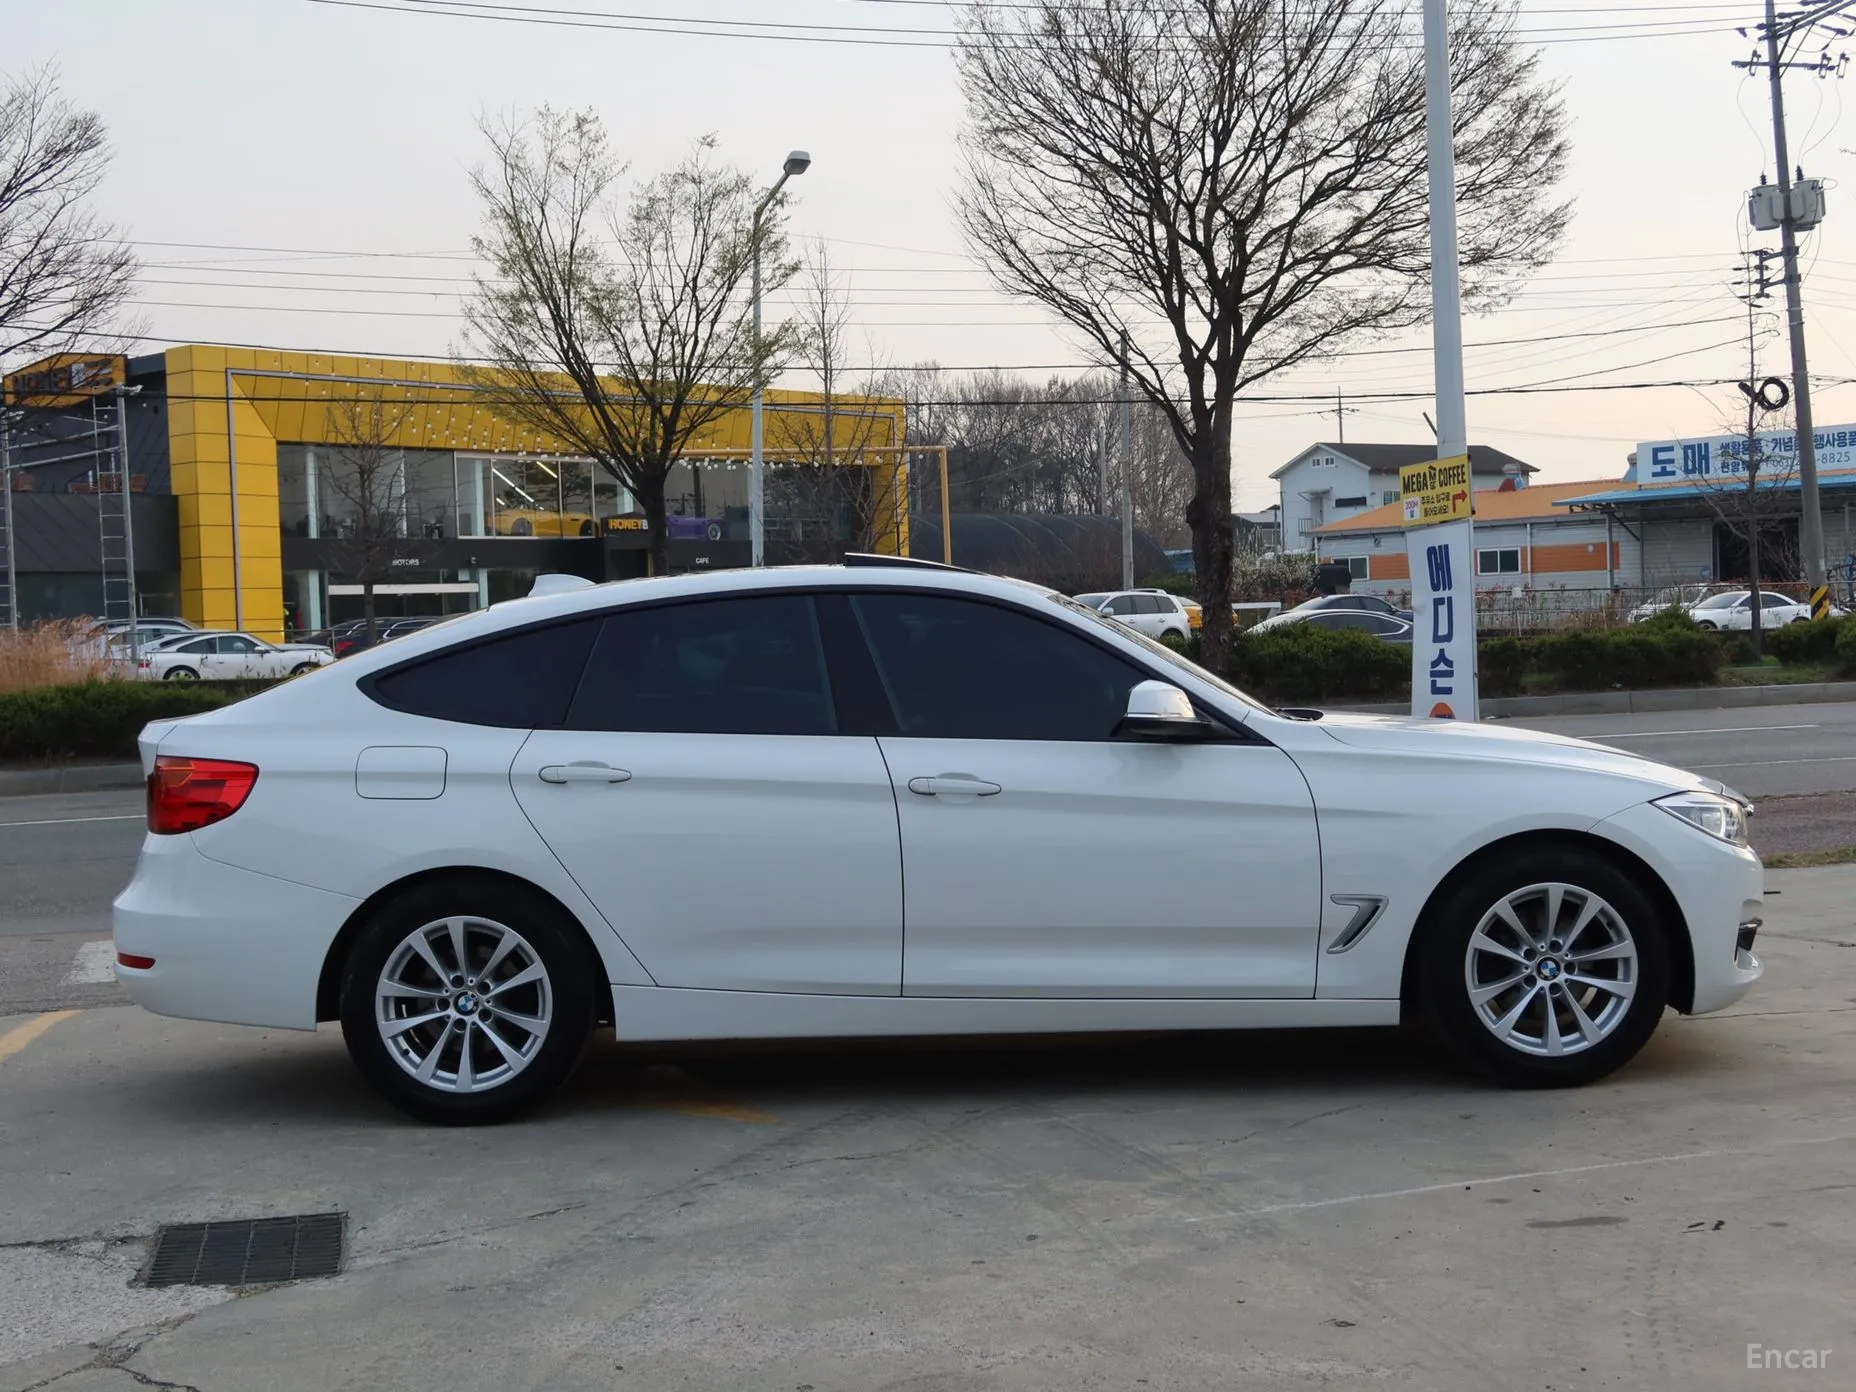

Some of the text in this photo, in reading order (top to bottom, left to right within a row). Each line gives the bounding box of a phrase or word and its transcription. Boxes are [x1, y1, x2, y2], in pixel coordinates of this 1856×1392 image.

[1652, 443, 1710, 477] 도매
[1403, 471, 1428, 494] MEGA
[1438, 464, 1466, 487] COFFEE
[1426, 544, 1454, 695] 에디슨
